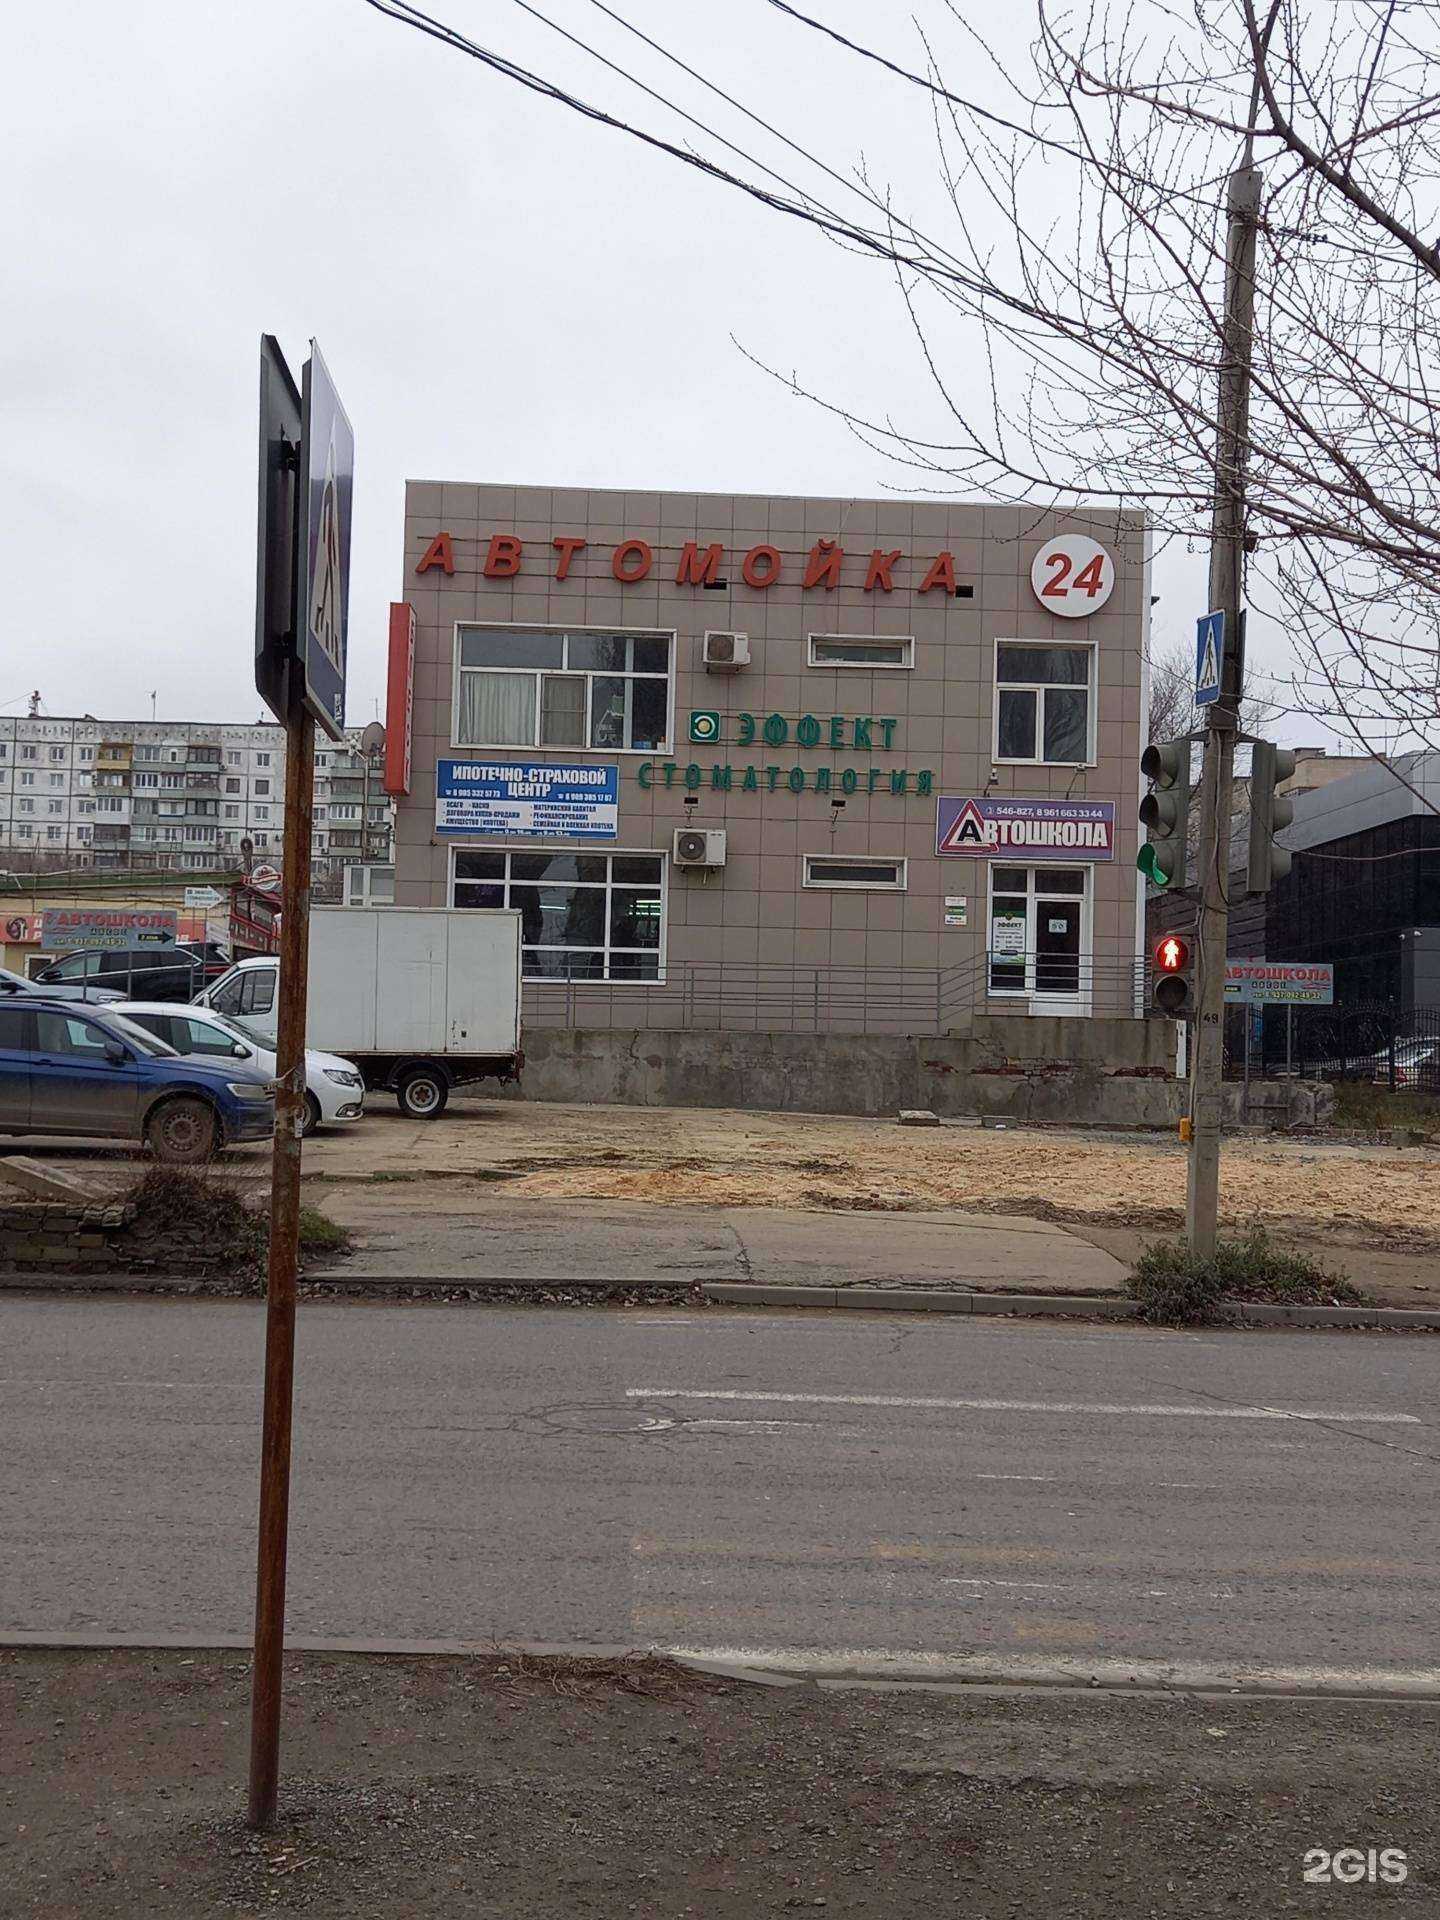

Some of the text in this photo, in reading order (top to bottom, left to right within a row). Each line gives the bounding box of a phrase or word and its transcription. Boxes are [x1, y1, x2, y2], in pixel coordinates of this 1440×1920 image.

[415, 531, 958, 594] АВТОМОЙКА
[1041, 552, 1105, 598] 24
[738, 712, 898, 751] ЭФФЕКТ
[452, 765, 607, 785] ИПОТЕЧНО-СТРАХОВОЙ
[638, 761, 933, 796] СТОМАТОЛОГИЯ
[507, 782, 551, 798] ЦЕНТР
[1037, 808, 1043, 816] 8
[1079, 809, 1090, 818] 33
[957, 819, 1109, 847] АВТОШКОЛА
[57, 910, 175, 928] АВТОШКОЛА
